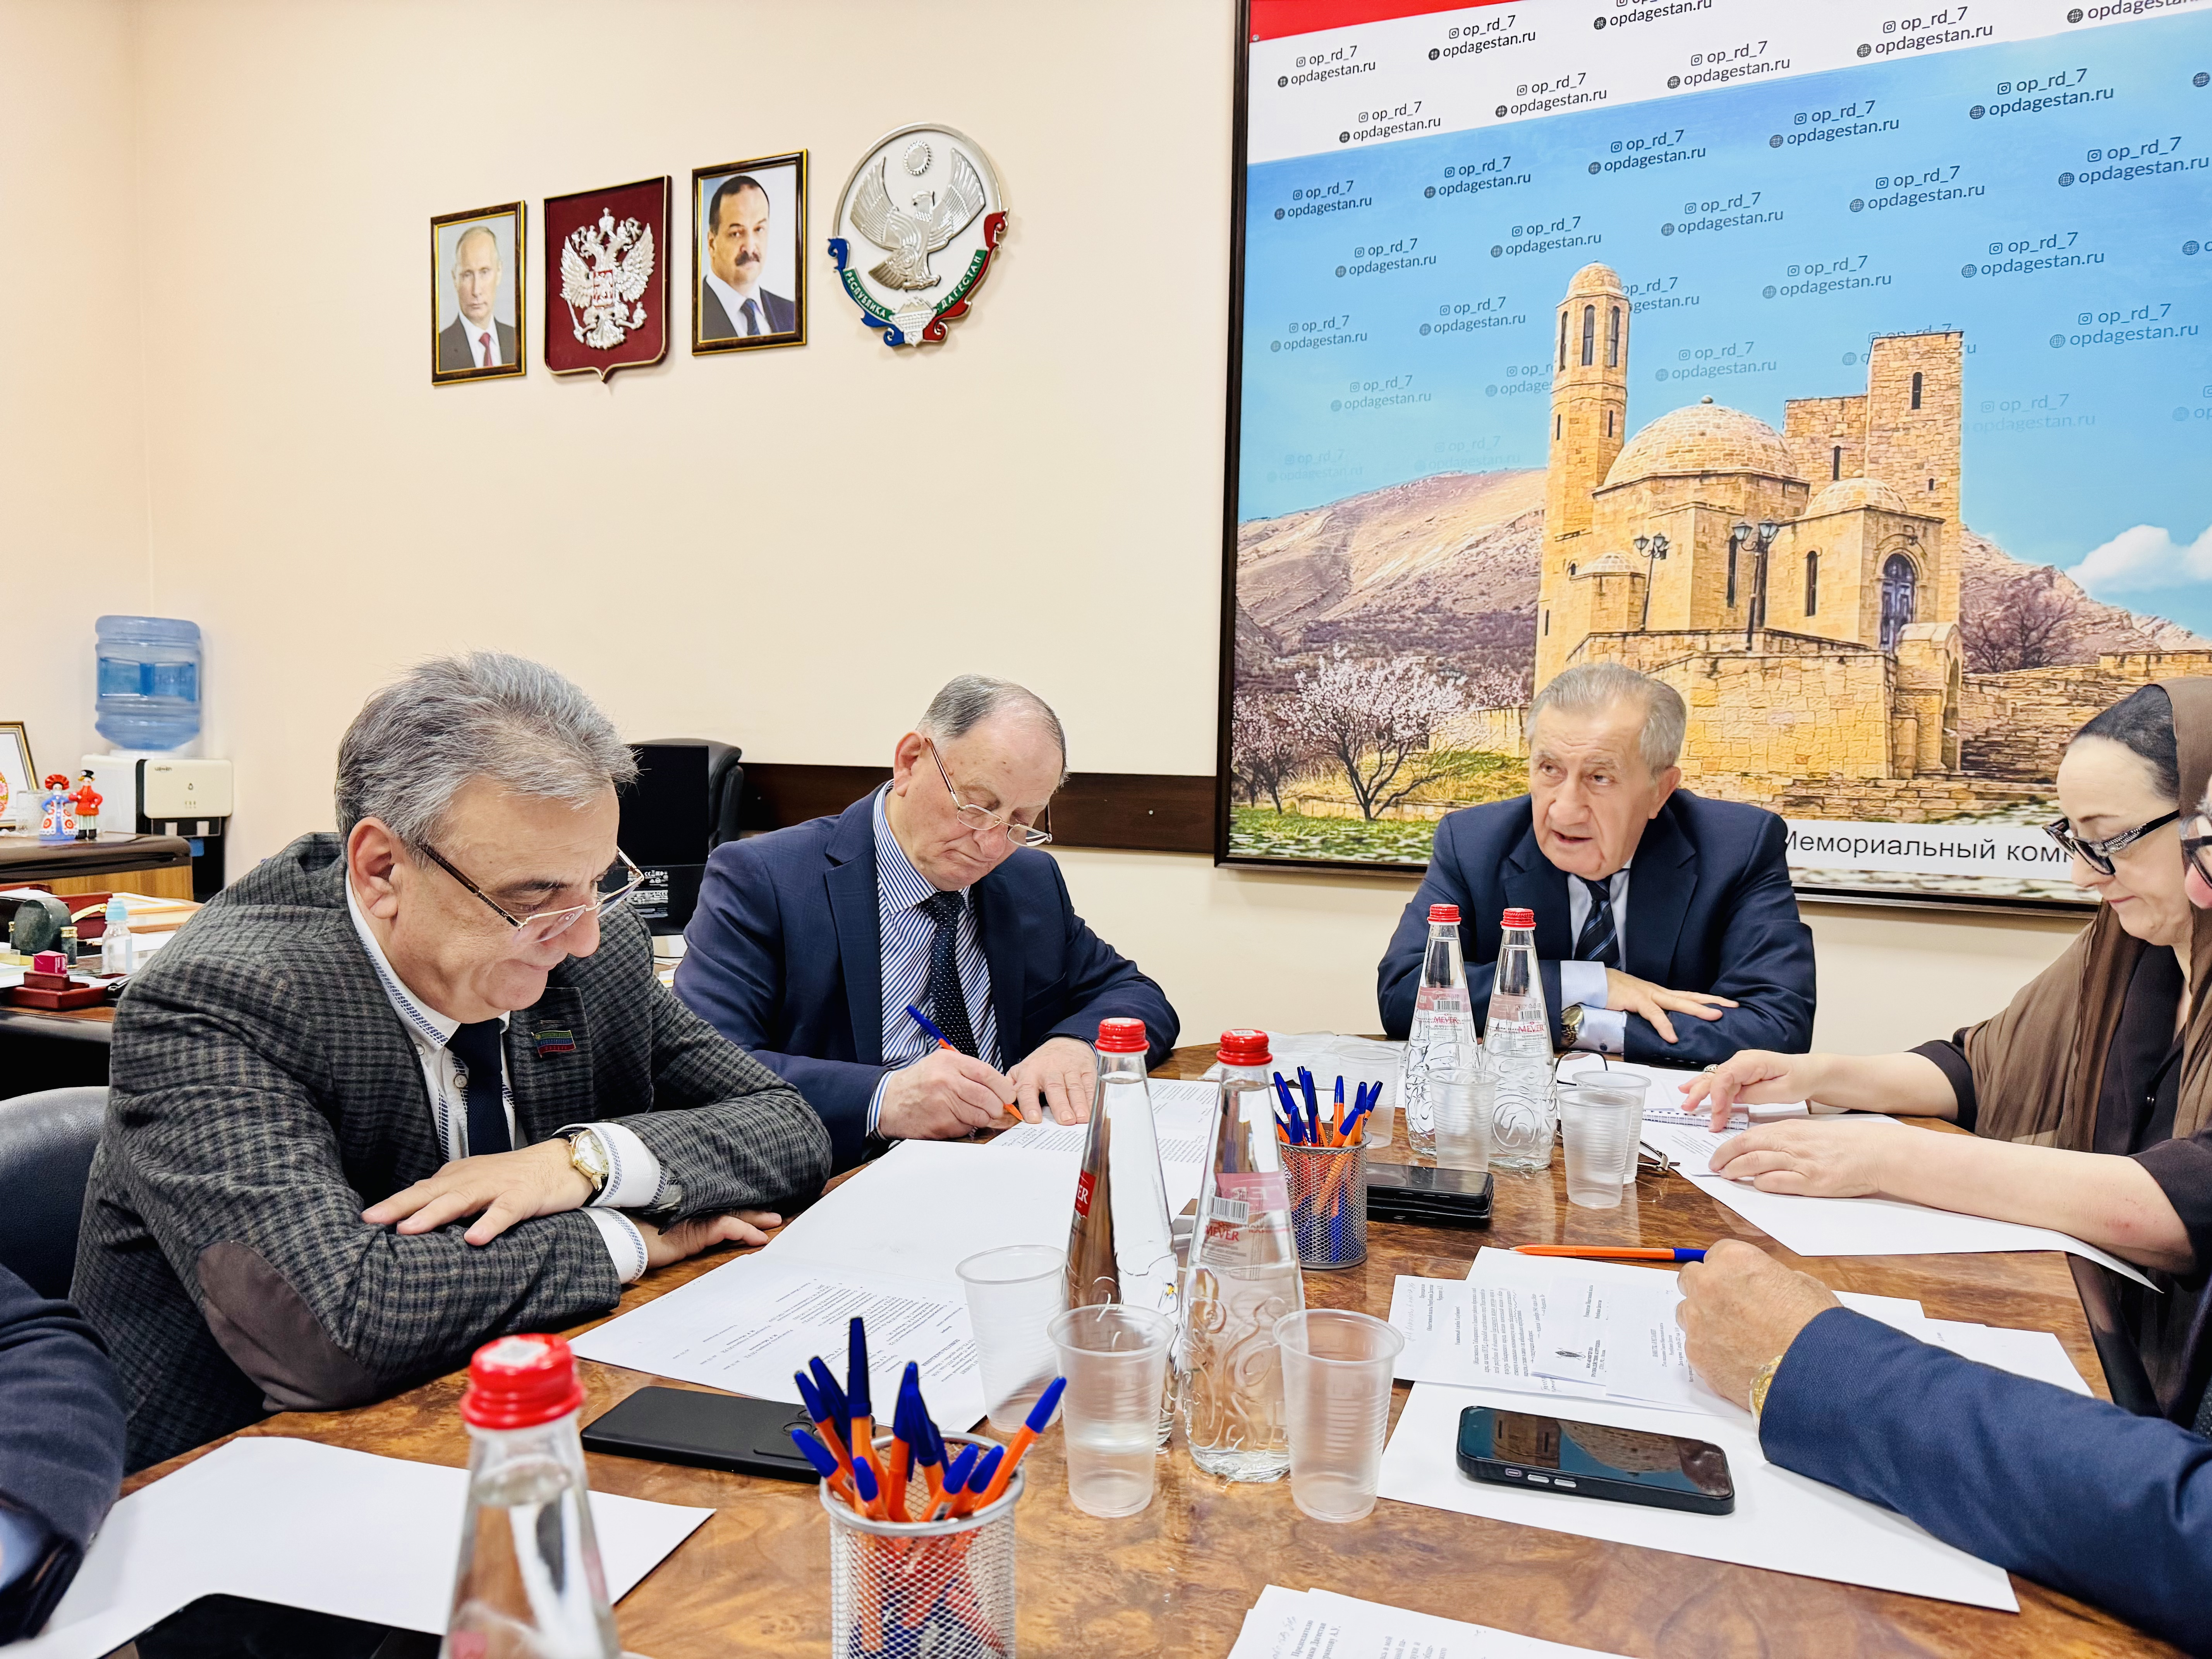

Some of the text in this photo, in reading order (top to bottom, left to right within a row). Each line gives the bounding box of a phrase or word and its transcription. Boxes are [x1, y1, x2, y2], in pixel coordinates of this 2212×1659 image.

[1610, 0, 1711, 27] opdagestan.ru
[1901, 6, 1968, 31] op_rd_7
[1463, 15, 1516, 38] op_rd_7
[1443, 30, 1535, 58] opdagestan.ru
[1876, 25, 1992, 55] opdagestan.ru
[1310, 45, 1358, 67] op_rd_7
[1707, 41, 1768, 64] op_rd_7
[1291, 59, 1375, 85] opdagestan.ru
[1532, 72, 1587, 95] op_rd_7
[1684, 58, 1790, 88] opdagestan.ru
[2017, 68, 2087, 93] op_rd_7
[1372, 101, 1422, 122] op_rd_7
[1511, 87, 1606, 115] opdagestan.ru
[1812, 100, 1875, 124] op_rd_7
[1989, 87, 2113, 117] opdagestan.ru
[1353, 115, 1440, 141] opdagestan.ru
[1787, 117, 1899, 146] opdagestan.ru
[1626, 129, 1684, 151] op_rd_7
[2107, 136, 2181, 161] op_rd_7
[1459, 156, 1511, 177] op_rd_7
[1604, 146, 1705, 173] opdagestan.ru
[2079, 155, 2209, 184] opdagestan.ru
[1439, 173, 1530, 196] opdagestan.ru
[1894, 165, 1960, 188] op_rd_7
[1306, 180, 1354, 200] op_rd_7
[1868, 182, 1985, 211] opdagestan.ru
[1288, 196, 1372, 218] opdagestan.ru
[1701, 192, 1761, 214] op_rd_7
[1527, 216, 1580, 236] op_rd_7
[1678, 209, 1783, 235] opdagestan.ru
[1368, 238, 1417, 257] op_rd_7
[1506, 232, 1601, 257] opdagestan.ru
[2008, 232, 2078, 254] op_rd_7
[1349, 254, 1436, 276] opdagestan.ru
[1805, 255, 1868, 276] op_rd_7
[1981, 250, 2104, 276] opdagestan.ru
[844, 255, 981, 318] РЕСПУБЛИКА ДАГЕСТАН
[1780, 273, 1891, 297] opdagestan.ru
[1454, 296, 1506, 316] op_rd_7
[1633, 296, 1699, 313] gestan.ru
[2098, 304, 2171, 325] op_rd_7
[1302, 315, 1349, 333] op_rd_7
[1434, 314, 1525, 335] opdagestan.ru
[2070, 323, 2198, 347] opdagestan.ru
[1284, 331, 1367, 351] opdagestan.ru
[1695, 341, 1754, 361] op_rd_7
[1672, 359, 1776, 381] opdagestan.ru
[1364, 375, 1412, 393] op_rd_7
[1345, 392, 1431, 410] opdagestan.ru
[2000, 393, 2069, 413] op_rd_7
[1518, 1024, 1544, 1033] MEVER
[1205, 1225, 1239, 1242] MEVER
[1291, 1620, 1313, 1657] Председателю
[1314, 1622, 1326, 1647] Дагестан
[1322, 1638, 1336, 1659] ркесову
